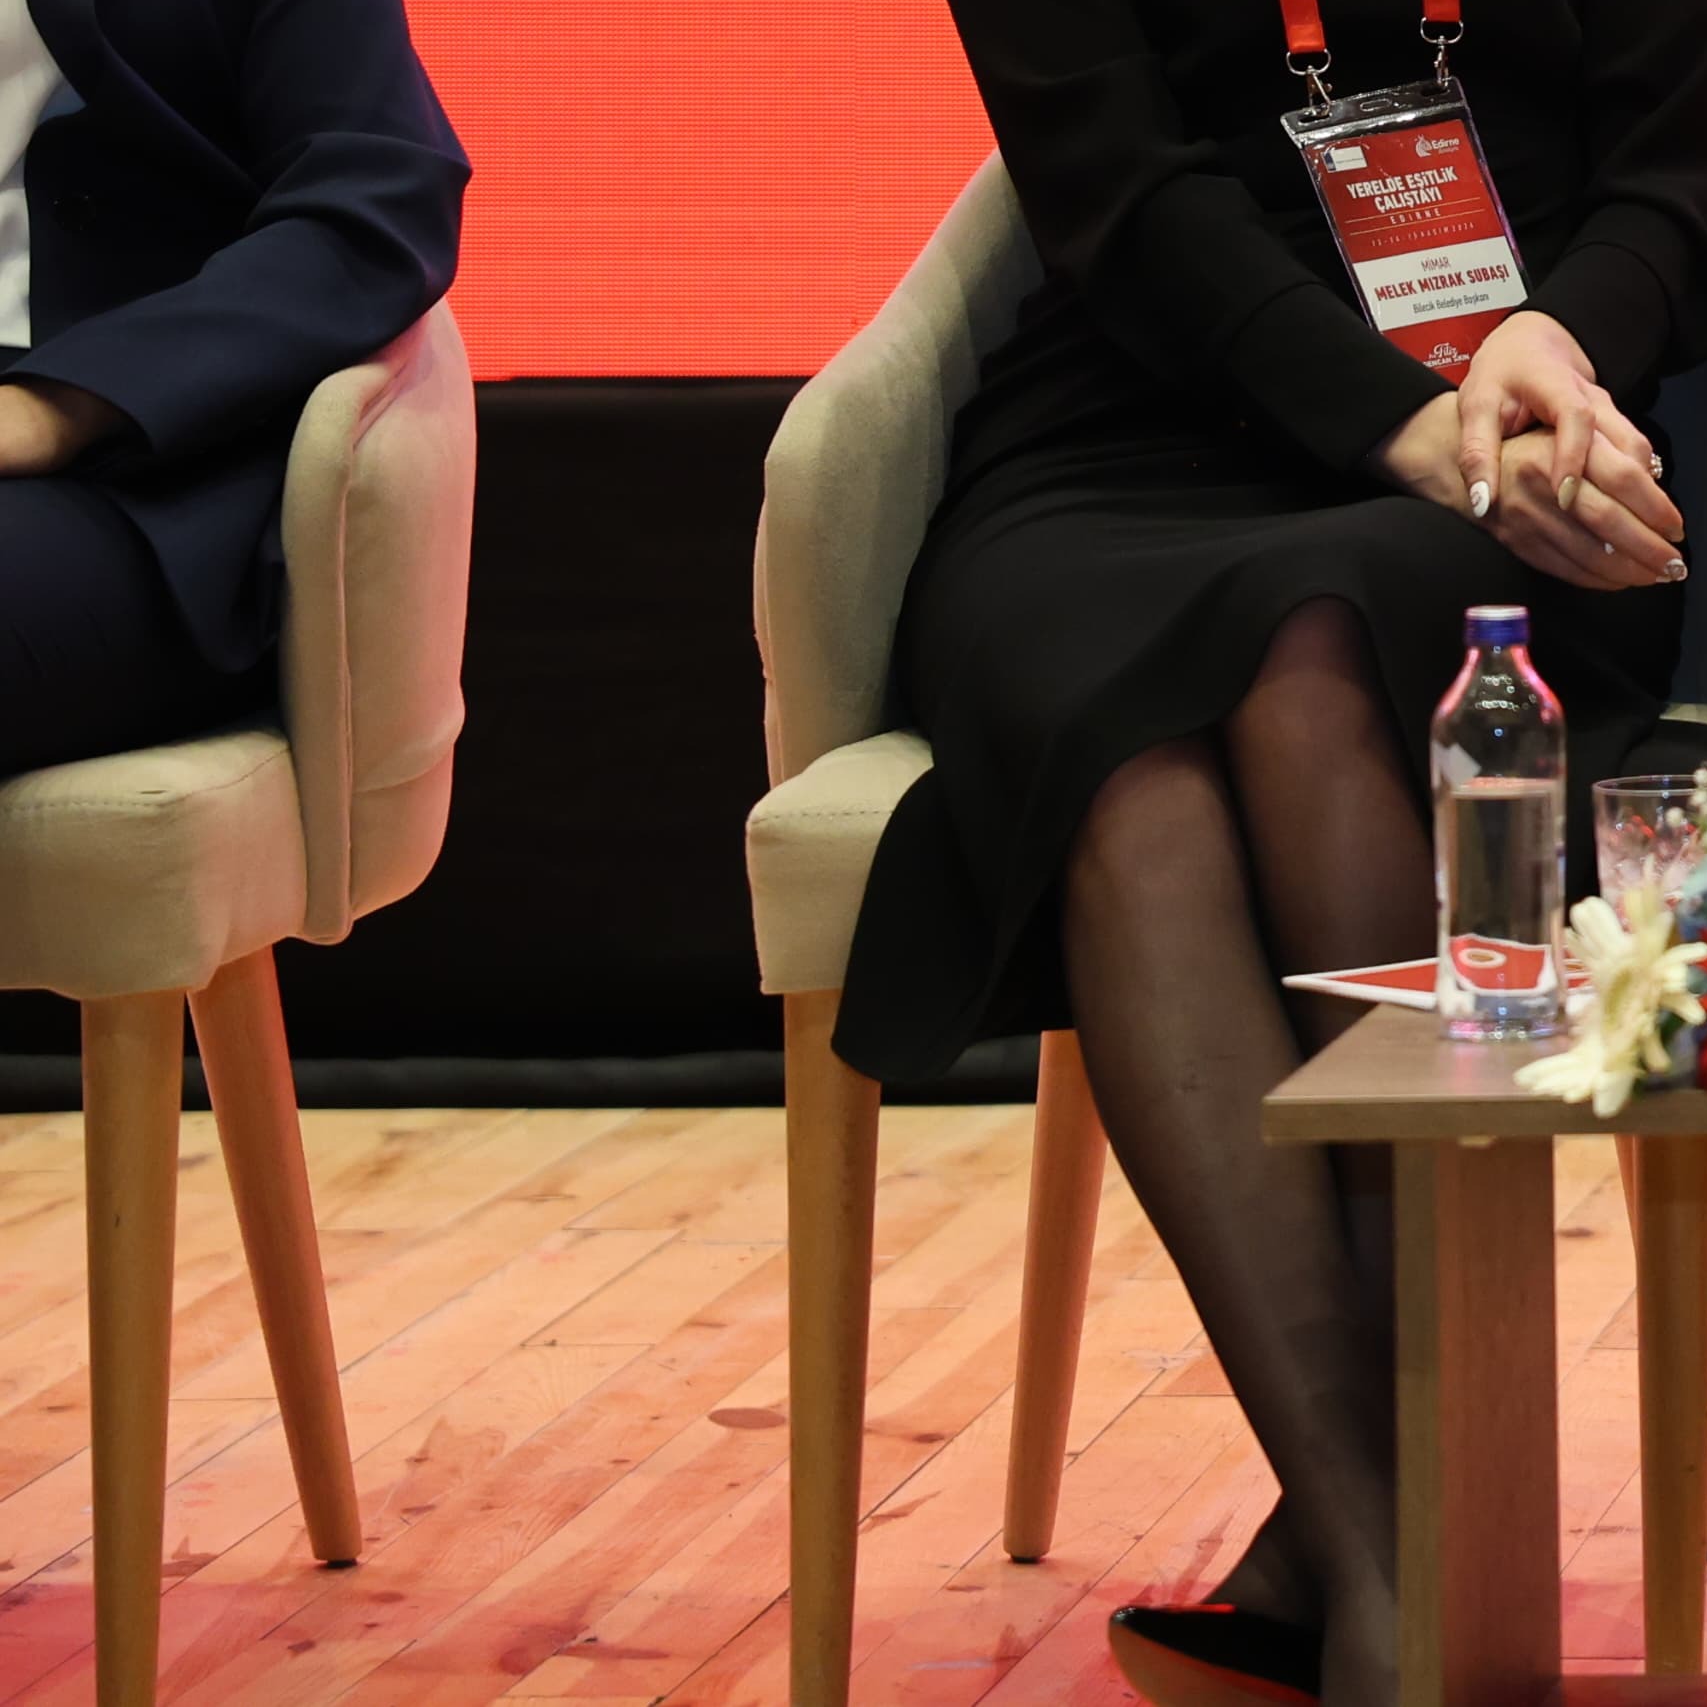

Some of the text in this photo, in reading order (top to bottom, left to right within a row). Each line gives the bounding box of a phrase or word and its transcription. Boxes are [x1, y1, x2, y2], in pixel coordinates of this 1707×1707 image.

[1432, 137, 1460, 150] Edirne
[1346, 176, 1407, 199] YERELDE
[1374, 186, 1443, 213] ÇALIŞTAYI
[1421, 256, 1452, 272] MİMAR
[1374, 263, 1510, 301] MELEK MIZRAK SUBAŞI
[1412, 301, 1436, 314] Bilecik
[1435, 297, 1463, 311] Belediye
